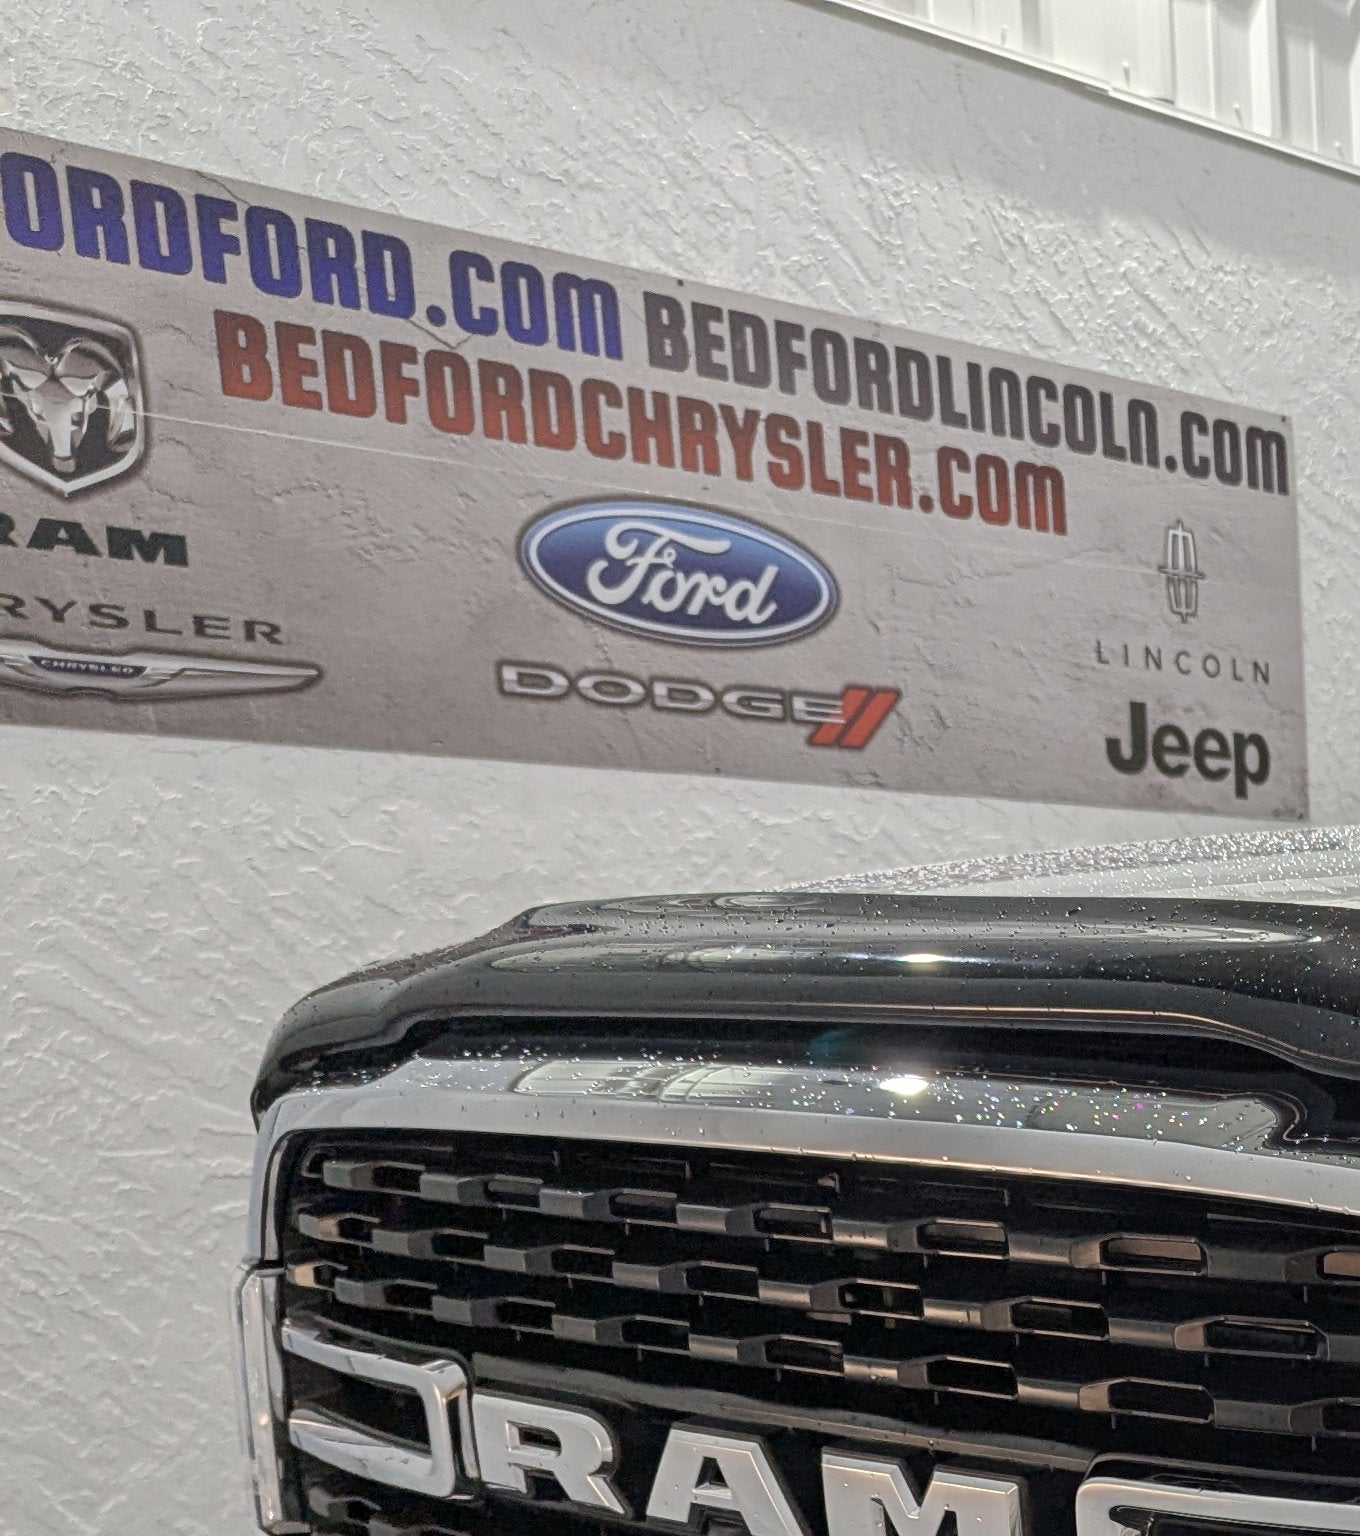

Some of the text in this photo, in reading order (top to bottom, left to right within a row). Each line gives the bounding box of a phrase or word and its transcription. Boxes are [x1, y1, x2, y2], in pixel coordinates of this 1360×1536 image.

[213, 308, 1067, 536] BEDFORDCHRYSLER.COM
[642, 289, 1290, 497] BEDFORDLINCOLN.COM
[0, 512, 189, 568] AM
[586, 520, 780, 625] Ford
[499, 663, 848, 725] DODGE
[1096, 639, 1270, 686] LINCOLN
[1106, 701, 1271, 799] Jeep
